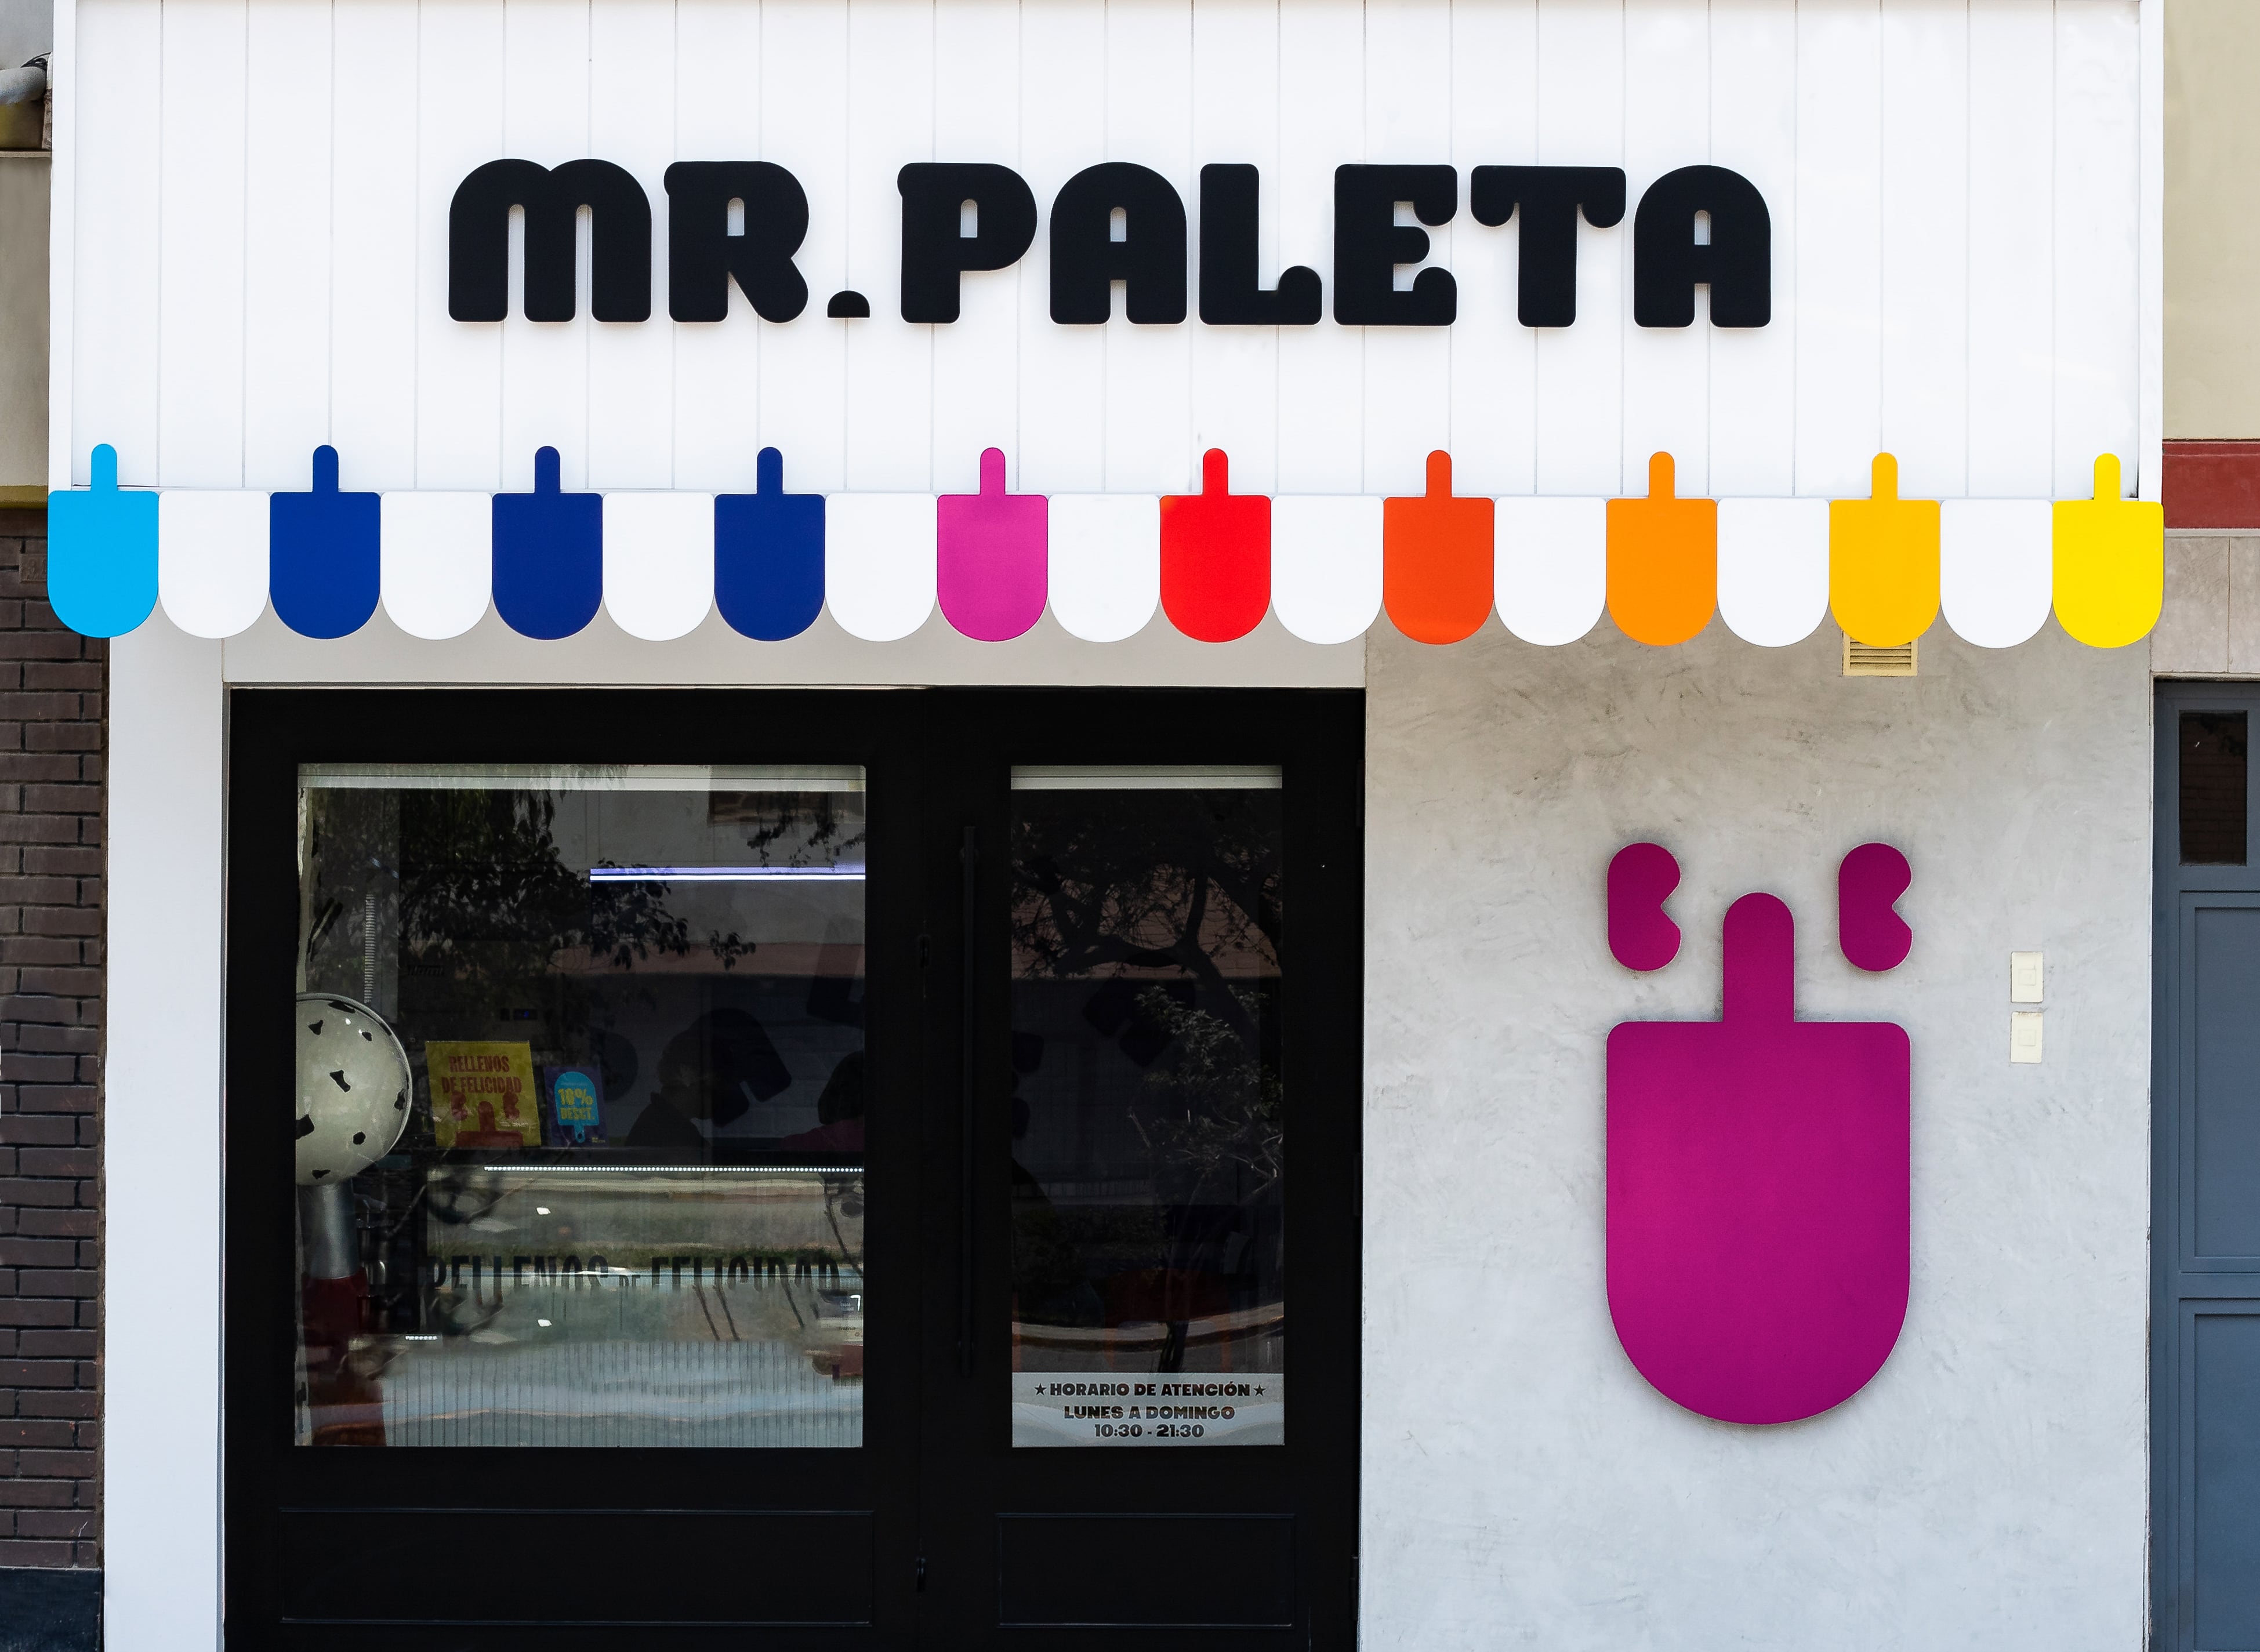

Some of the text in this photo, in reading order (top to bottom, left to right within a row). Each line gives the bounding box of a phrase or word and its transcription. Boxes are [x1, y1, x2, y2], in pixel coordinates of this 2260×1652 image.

[449, 159, 1771, 328] MR. PALETA
[448, 1055, 510, 1073] RELLENOS
[441, 1076, 522, 1094] DE FELICIDAD
[558, 1088, 594, 1106] 10%
[560, 1107, 595, 1120] DESCT.
[1050, 1381, 1250, 1397] HORARIO DE ATENCIÓN
[1064, 1406, 1235, 1419] LUNES A DOMINGO
[1094, 1424, 1143, 1437] 10:30
[1156, 1424, 1205, 1437] 21:30
